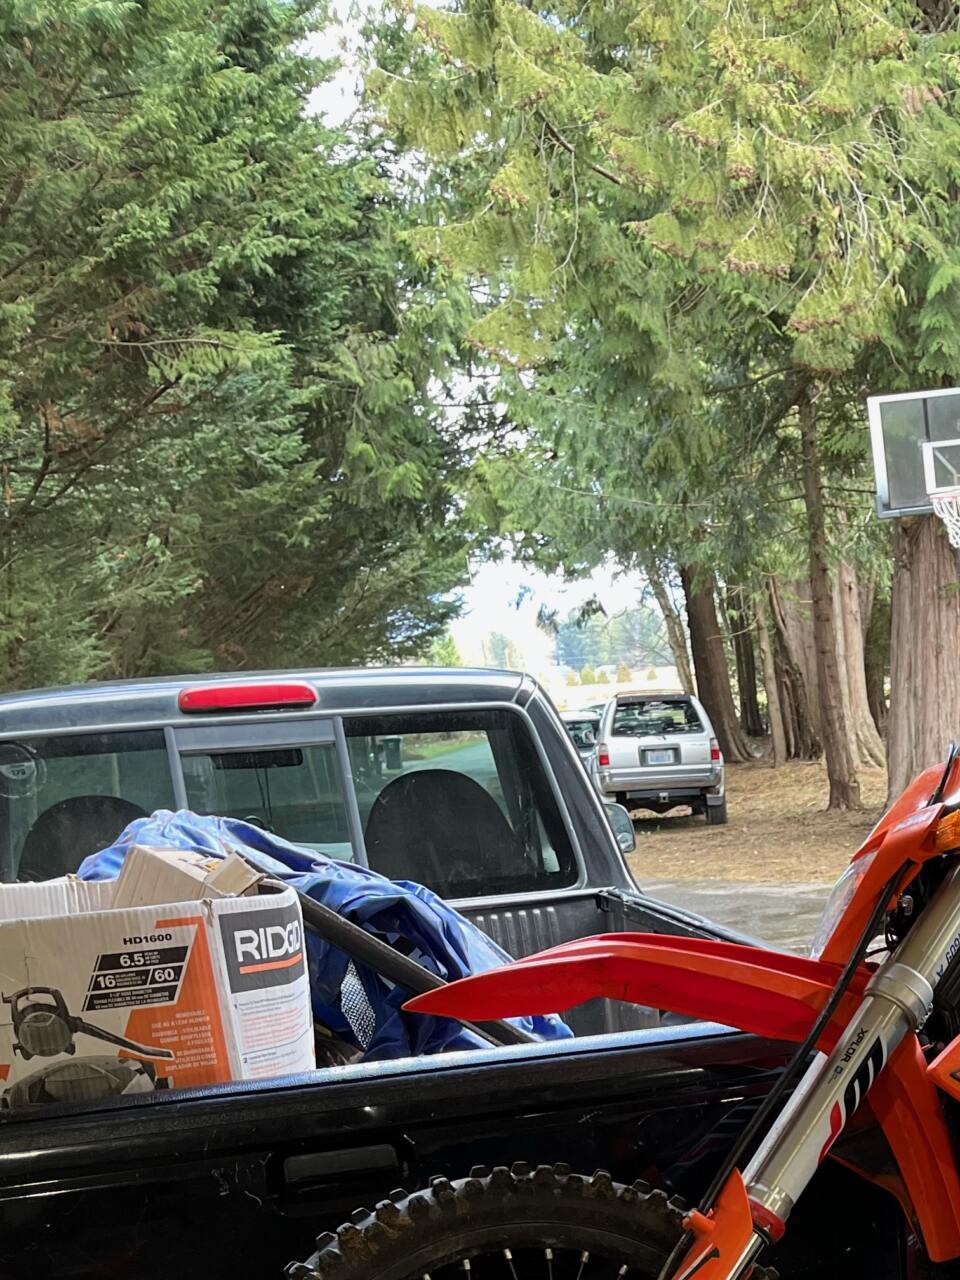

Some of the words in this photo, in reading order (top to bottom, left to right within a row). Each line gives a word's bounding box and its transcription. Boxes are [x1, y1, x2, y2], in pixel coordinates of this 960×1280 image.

[123, 933, 173, 945] HD1600
[119, 953, 145, 967] 6.5
[96, 974, 116, 988] 16
[154, 968, 175, 982] 60
[840, 1027, 869, 1063] XPLOR
